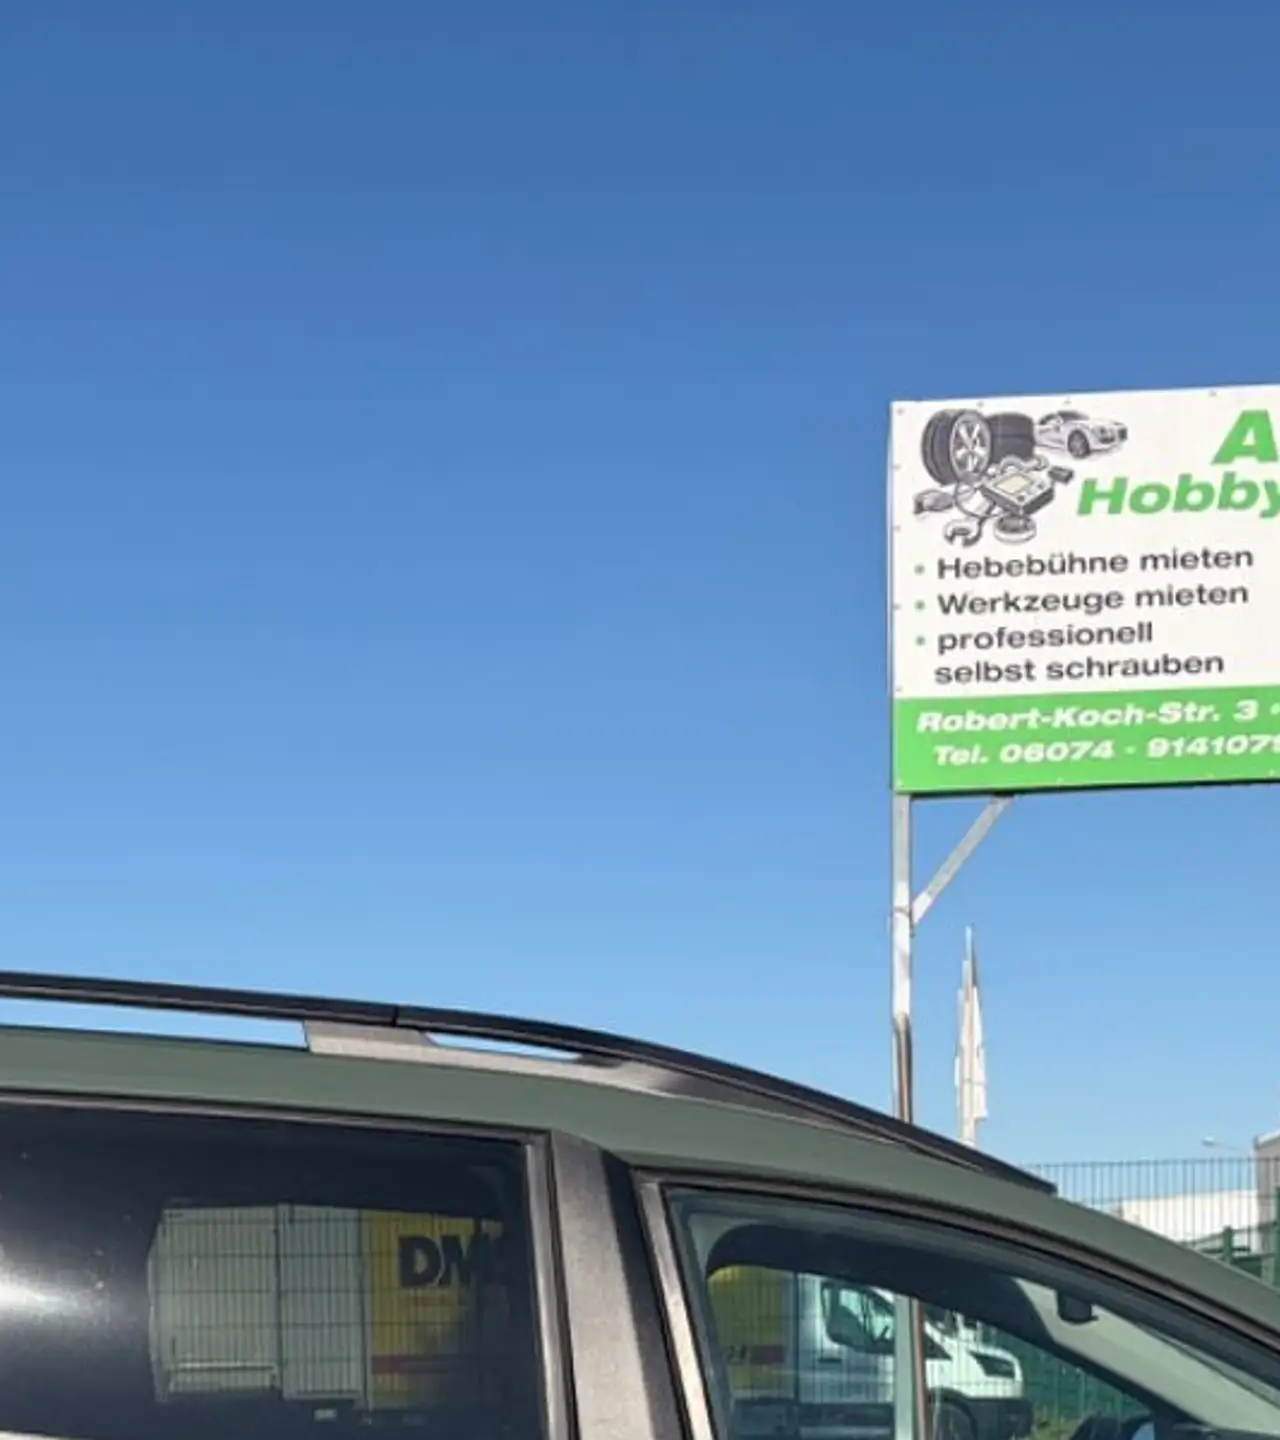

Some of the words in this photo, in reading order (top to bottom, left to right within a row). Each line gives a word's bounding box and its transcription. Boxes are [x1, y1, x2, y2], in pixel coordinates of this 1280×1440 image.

[937, 552, 1128, 580] Hebebühne
[1140, 546, 1254, 571] mieten
[937, 588, 1124, 615] Werkzeuge
[1135, 583, 1249, 607] mieten
[938, 621, 1153, 655] professionell
[934, 658, 1037, 685] selbst
[1046, 653, 1225, 680] schrauben
[916, 701, 1221, 733] Robert-Koch-Str.
[1233, 700, 1259, 721] 3
[933, 745, 989, 766] Tel.
